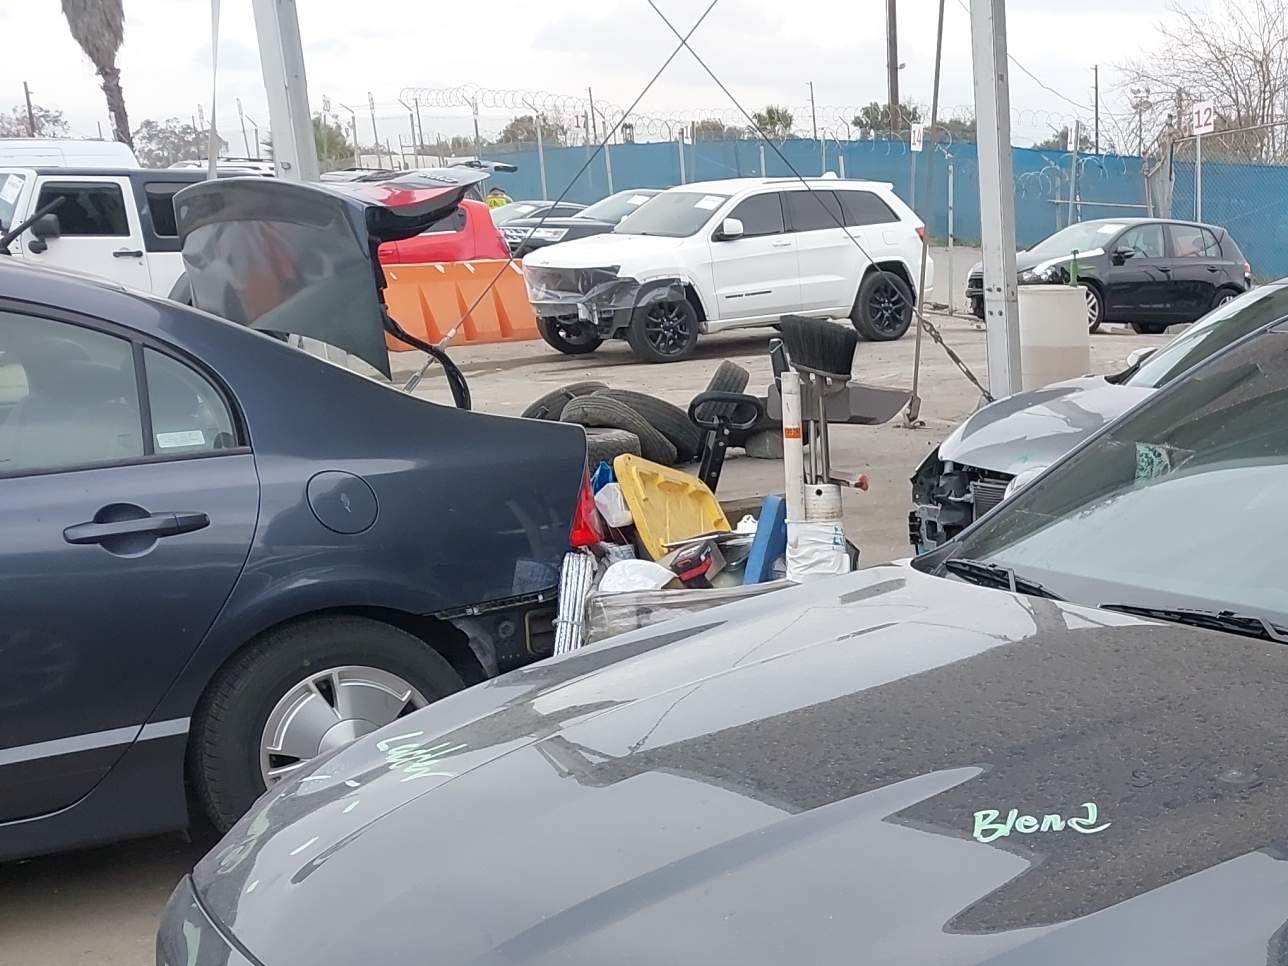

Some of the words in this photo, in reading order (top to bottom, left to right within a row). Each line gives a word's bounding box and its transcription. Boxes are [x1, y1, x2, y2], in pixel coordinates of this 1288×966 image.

[1194, 107, 1212, 129] 12
[912, 128, 922, 146] 14
[973, 802, 1112, 843] Blend
